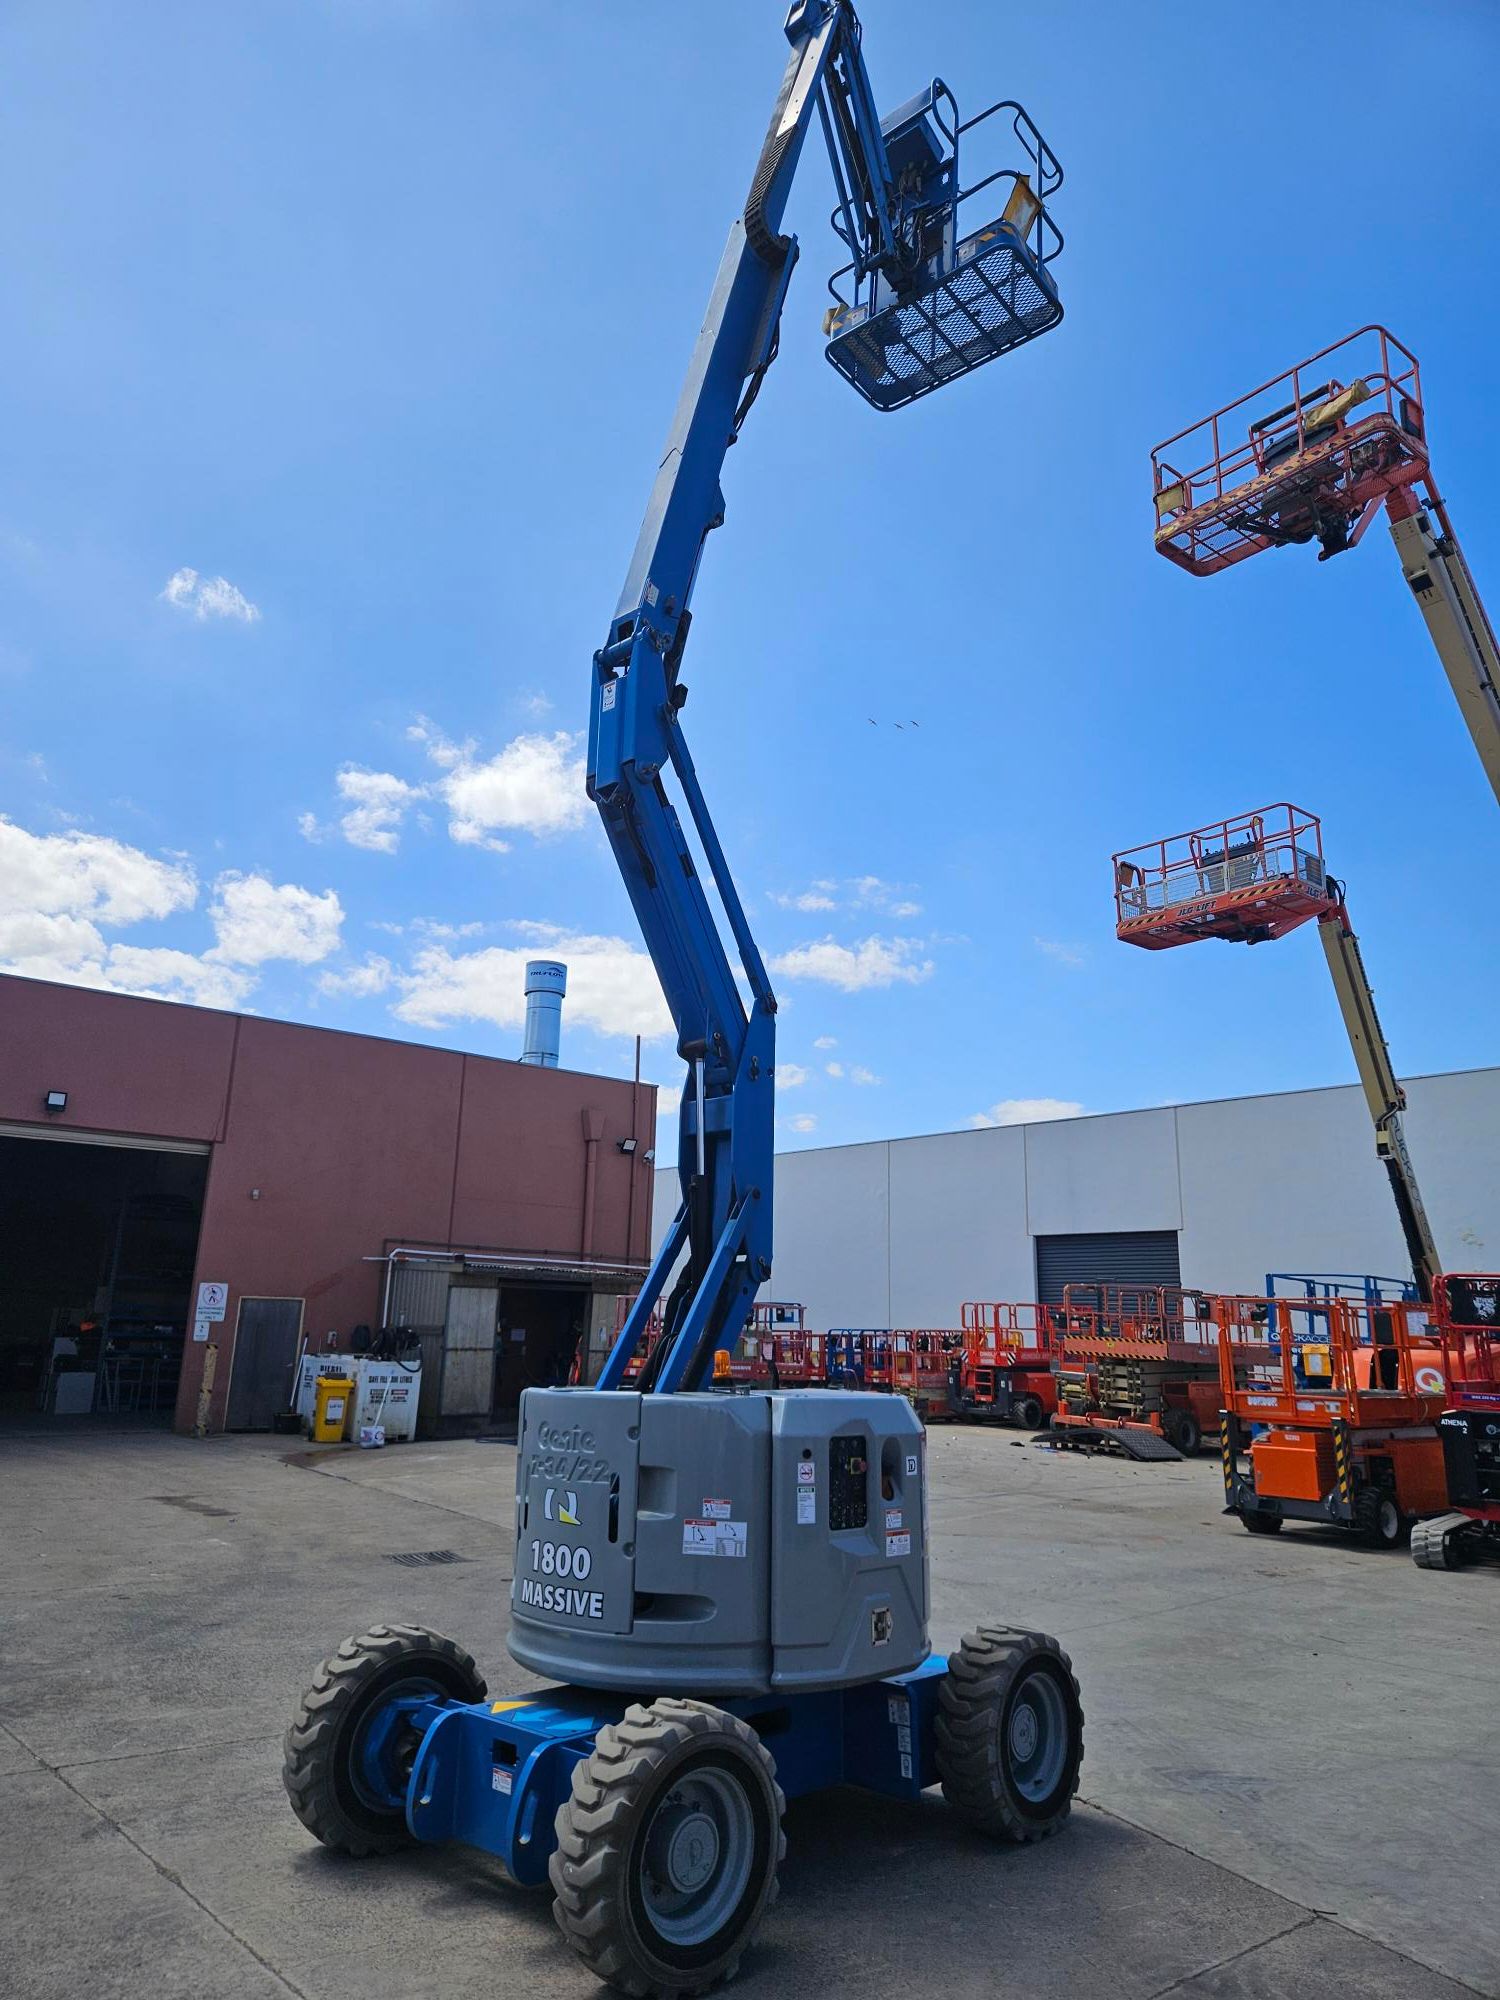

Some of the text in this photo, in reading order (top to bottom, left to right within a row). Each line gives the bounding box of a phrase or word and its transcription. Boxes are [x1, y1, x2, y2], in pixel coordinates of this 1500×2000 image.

[1178, 901, 1216, 916] JLG LIFT
[1441, 1418, 1468, 1427] ATHENA
[1462, 1427, 1468, 1435] 2
[538, 1420, 596, 1454] Genie
[531, 1539, 593, 1581] 1800
[521, 1577, 605, 1619] MASSIVE
